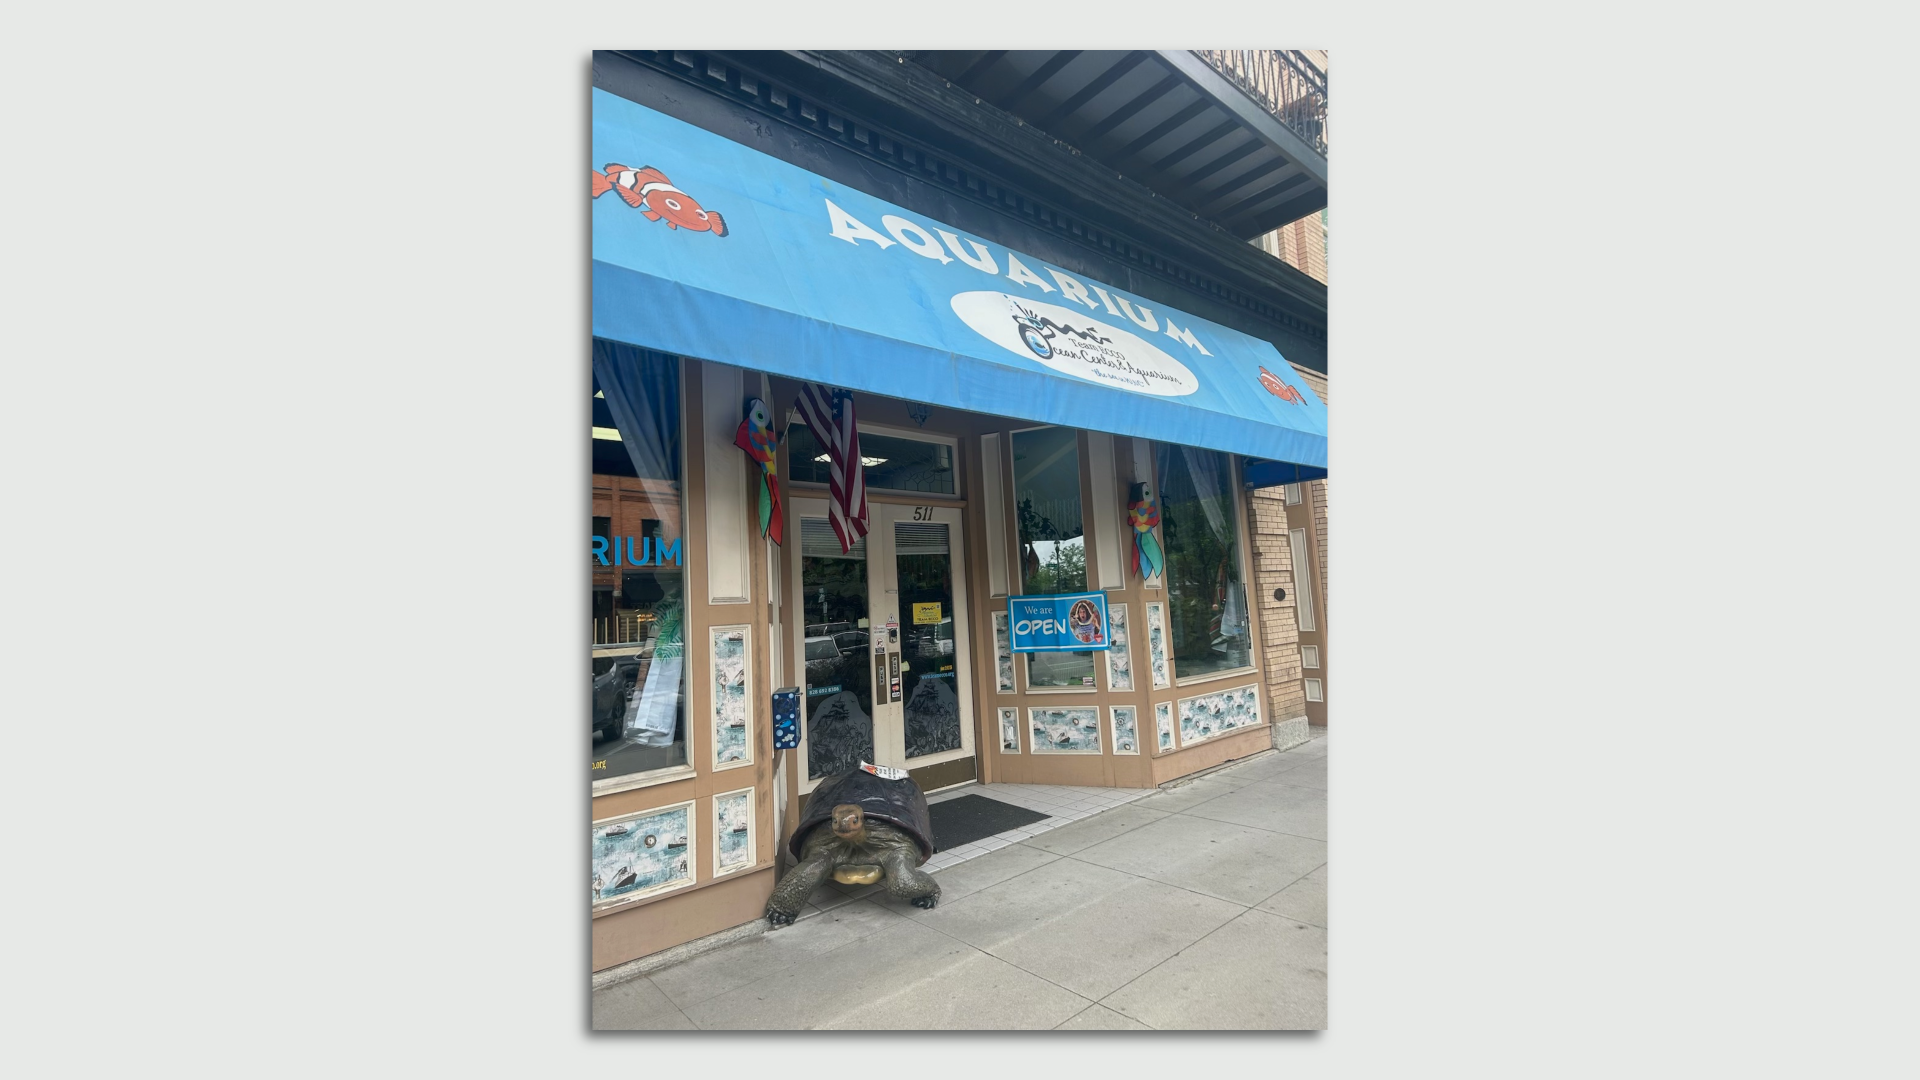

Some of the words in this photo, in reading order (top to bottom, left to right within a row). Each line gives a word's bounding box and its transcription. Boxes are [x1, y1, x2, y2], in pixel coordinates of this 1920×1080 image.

[825, 198, 1214, 357] AQUARIUM
[1068, 338, 1098, 353] Team
[1097, 344, 1126, 360] ECCO
[1126, 361, 1183, 386] Aquarium
[913, 506, 934, 521] 511
[592, 535, 682, 567] RIUM
[1024, 606, 1038, 614] We
[1015, 619, 1066, 635] OPEN
